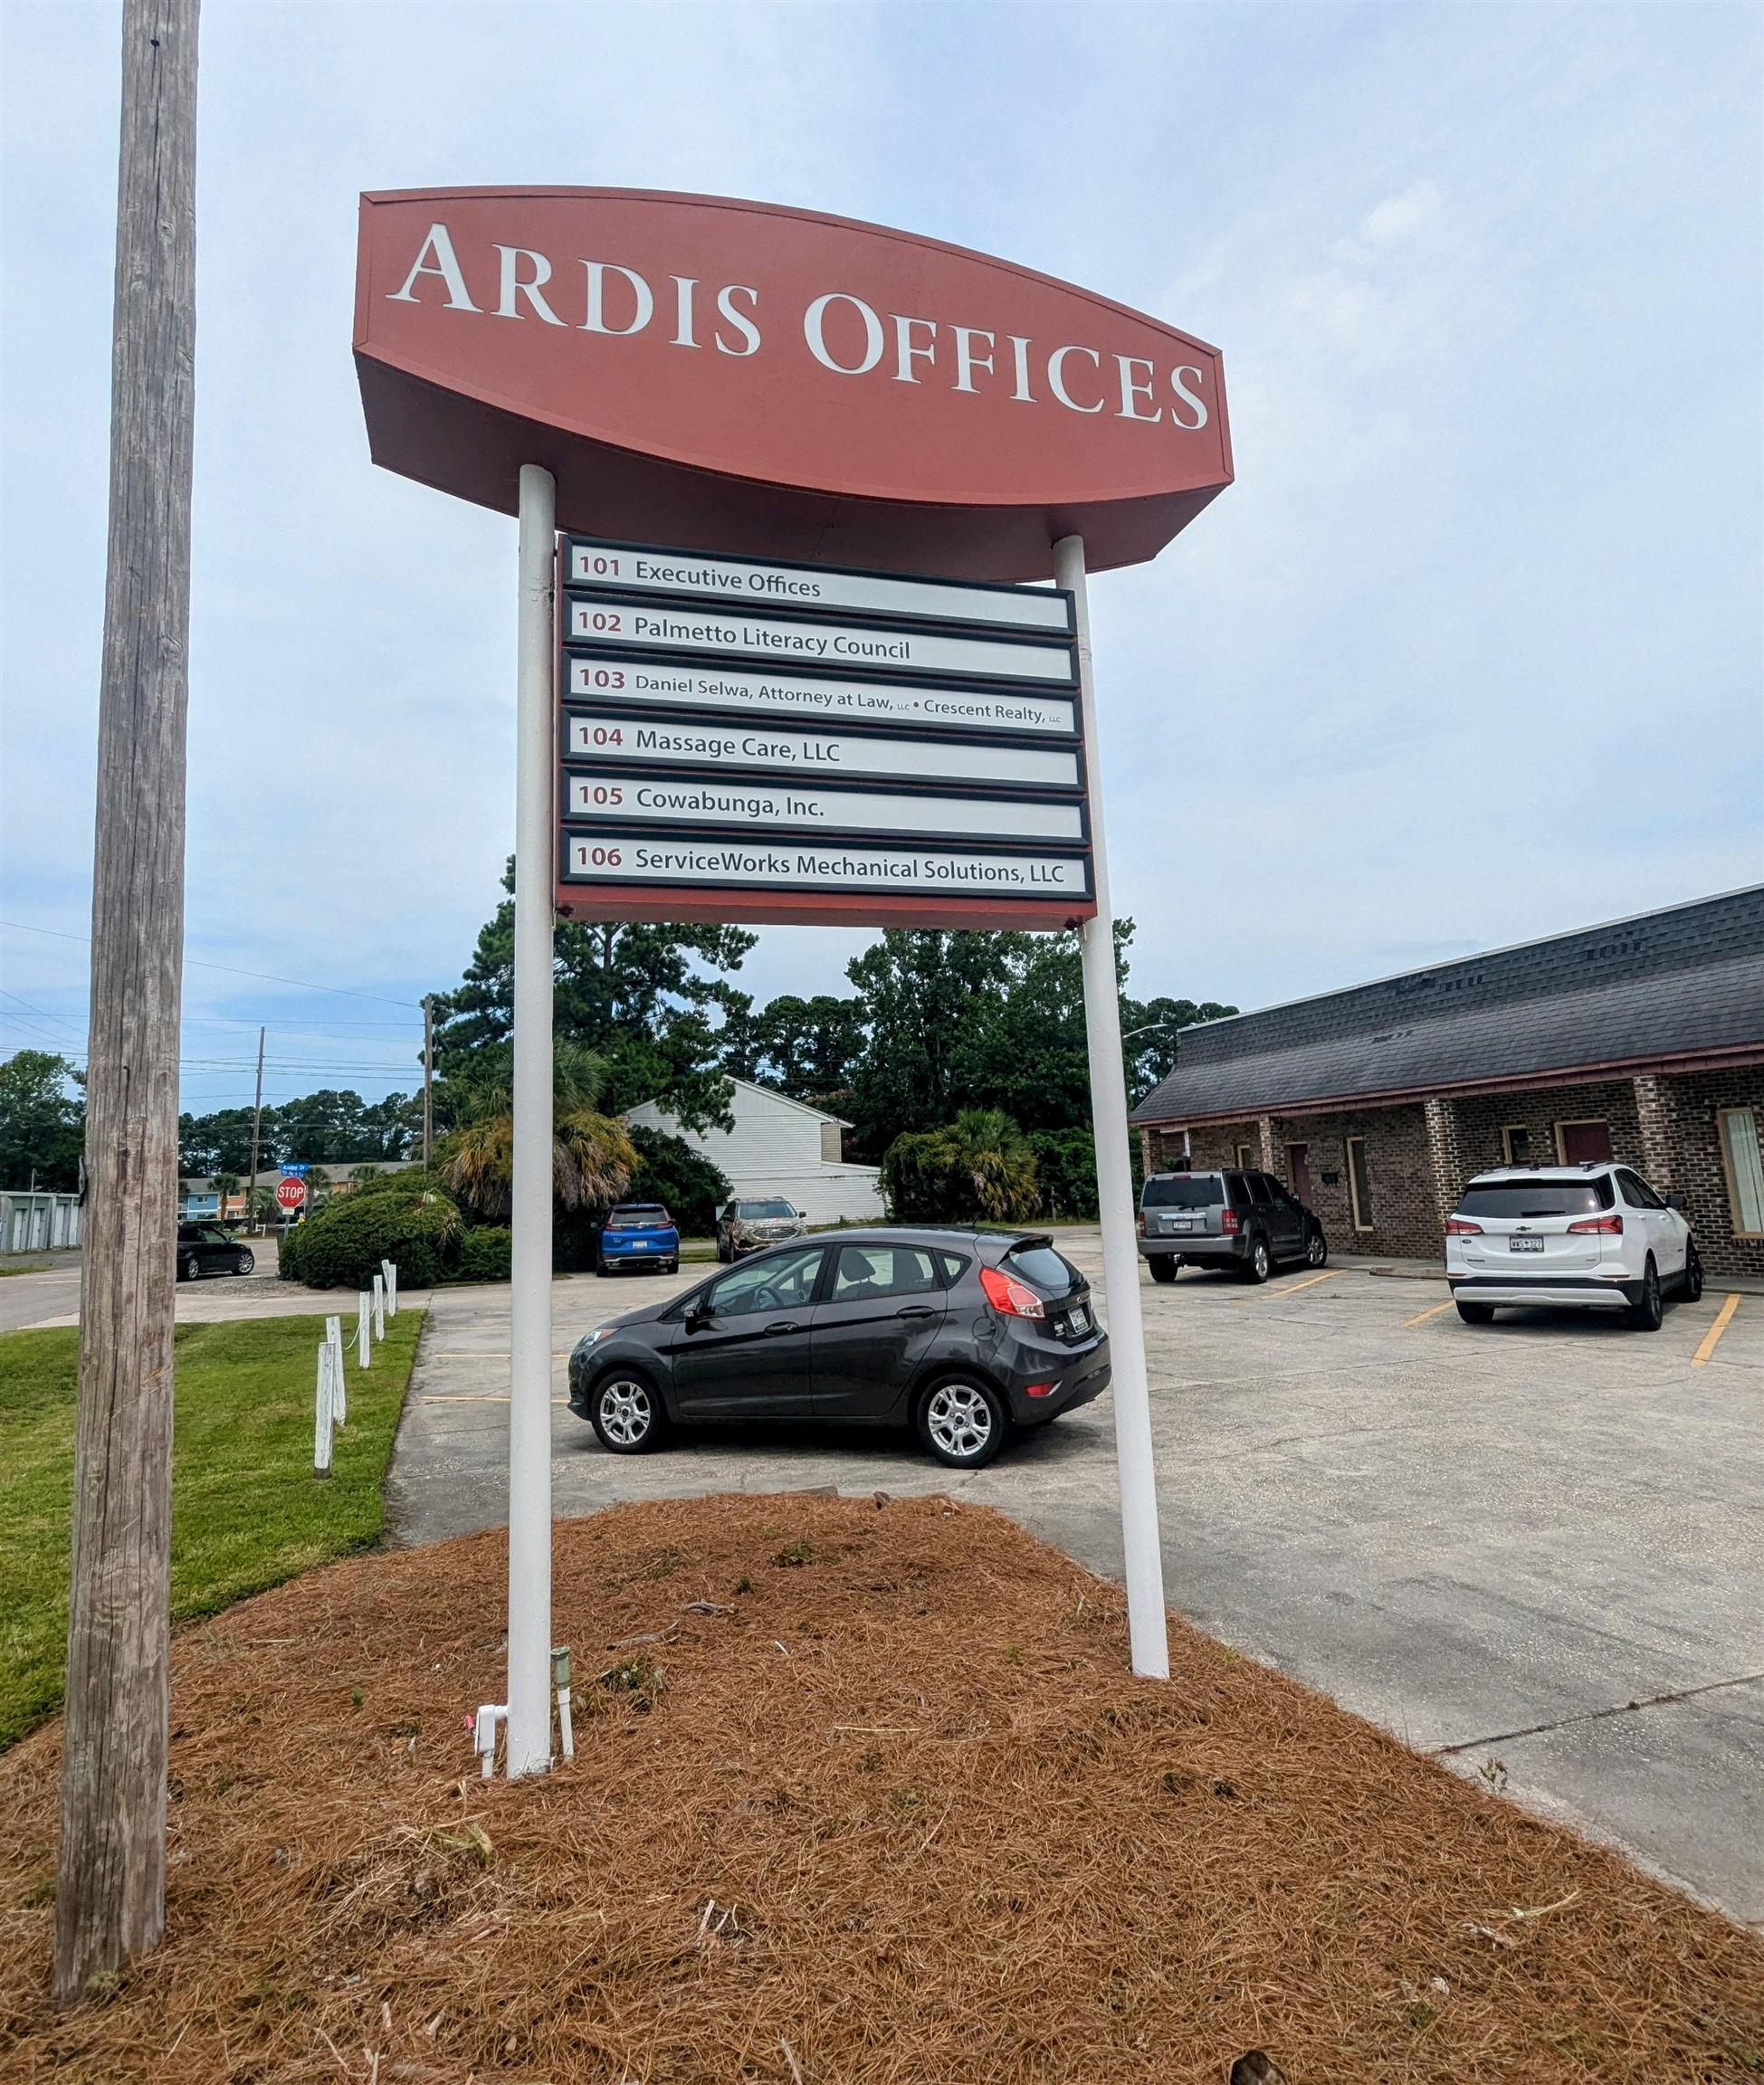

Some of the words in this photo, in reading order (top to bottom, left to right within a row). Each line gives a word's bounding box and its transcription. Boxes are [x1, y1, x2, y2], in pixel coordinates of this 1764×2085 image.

[386, 223, 761, 357] ARDIS
[803, 292, 1209, 431] OFFICES
[579, 557, 619, 576] 101
[636, 561, 742, 589] Executive
[749, 574, 821, 597] Offices
[579, 612, 622, 632] 102
[635, 617, 737, 643] Palmetto
[743, 627, 827, 655] Literacy
[834, 636, 910, 659] Council
[579, 669, 625, 689] 103
[636, 675, 692, 693] Daniel
[698, 680, 753, 700] Selwa,
[758, 686, 833, 707] Attorney
[838, 694, 853, 706] at
[858, 694, 893, 711] Law,
[924, 700, 991, 718] Crescent
[996, 706, 1045, 723] Realty,
[579, 727, 623, 746] 104
[636, 730, 736, 757] Massage
[742, 738, 796, 761] Care,
[804, 743, 840, 761] LLC
[579, 785, 623, 805] 105
[636, 788, 779, 817] Cowabunga,
[787, 797, 825, 816] Inc.
[577, 847, 623, 866] 106
[635, 849, 790, 874] ServiceWorks
[797, 855, 918, 878] Mechanical
[924, 862, 1025, 885] Solutions,
[1030, 865, 1064, 883] LLC
[278, 1186, 303, 1198] STOP
